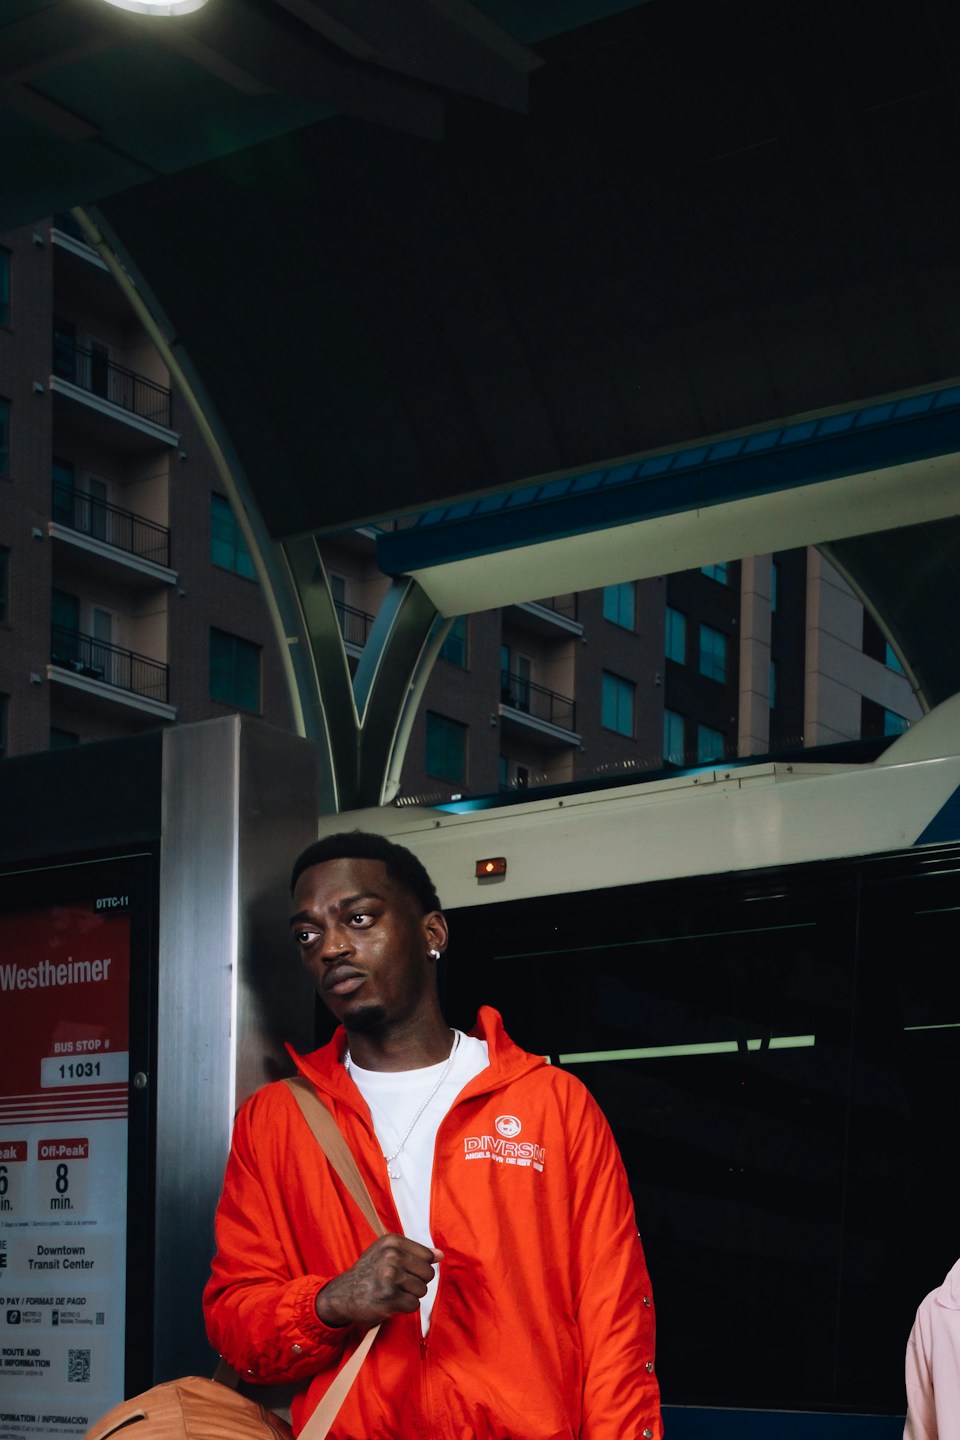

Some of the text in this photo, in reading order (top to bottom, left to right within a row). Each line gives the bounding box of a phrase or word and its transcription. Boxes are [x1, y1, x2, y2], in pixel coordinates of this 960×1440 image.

[96, 895, 129, 909] DTTC-11
[0, 956, 112, 992] Westheimer
[54, 1041, 74, 1053] BUS
[76, 1039, 101, 1051] STOP
[59, 1062, 101, 1079] 11031
[41, 1144, 85, 1157] Off-Peak
[464, 1135, 546, 1165] DIVRSN
[56, 1163, 68, 1194] 8
[50, 1194, 73, 1210] min.
[37, 1245, 85, 1256] Downtown
[28, 1259, 95, 1270] Transit Center
[7, 1297, 20, 1305] PAY
[55, 1297, 65, 1305] DE
[67, 1297, 87, 1306] PAGO
[2, 1348, 41, 1357] ROUTE AND
[4, 1360, 51, 1368] INFORMATION
